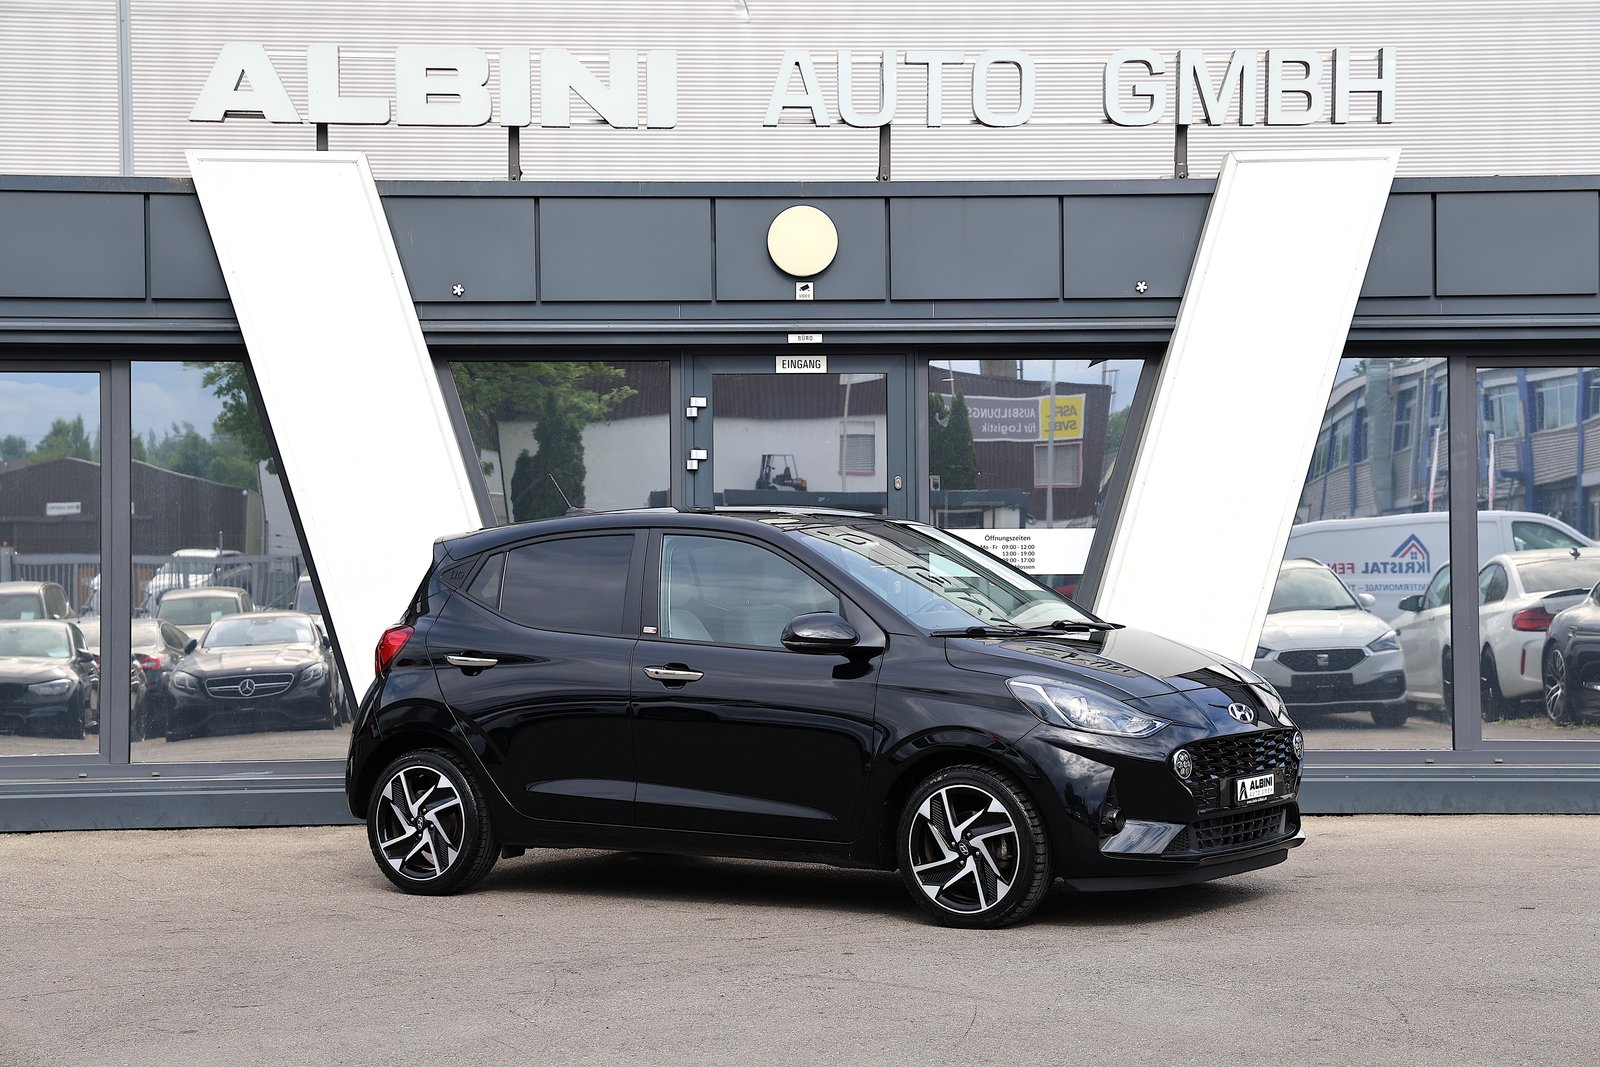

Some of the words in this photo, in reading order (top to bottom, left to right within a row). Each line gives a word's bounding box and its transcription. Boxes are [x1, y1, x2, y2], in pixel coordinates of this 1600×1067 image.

[188, 42, 678, 129] ALBINI
[763, 48, 1036, 128] AUTO
[1103, 46, 1398, 127] GMBH
[781, 359, 821, 369] EINGANG
[984, 533, 1031, 542] Öffnungszeiten
[1250, 776, 1272, 790] ALBINI
